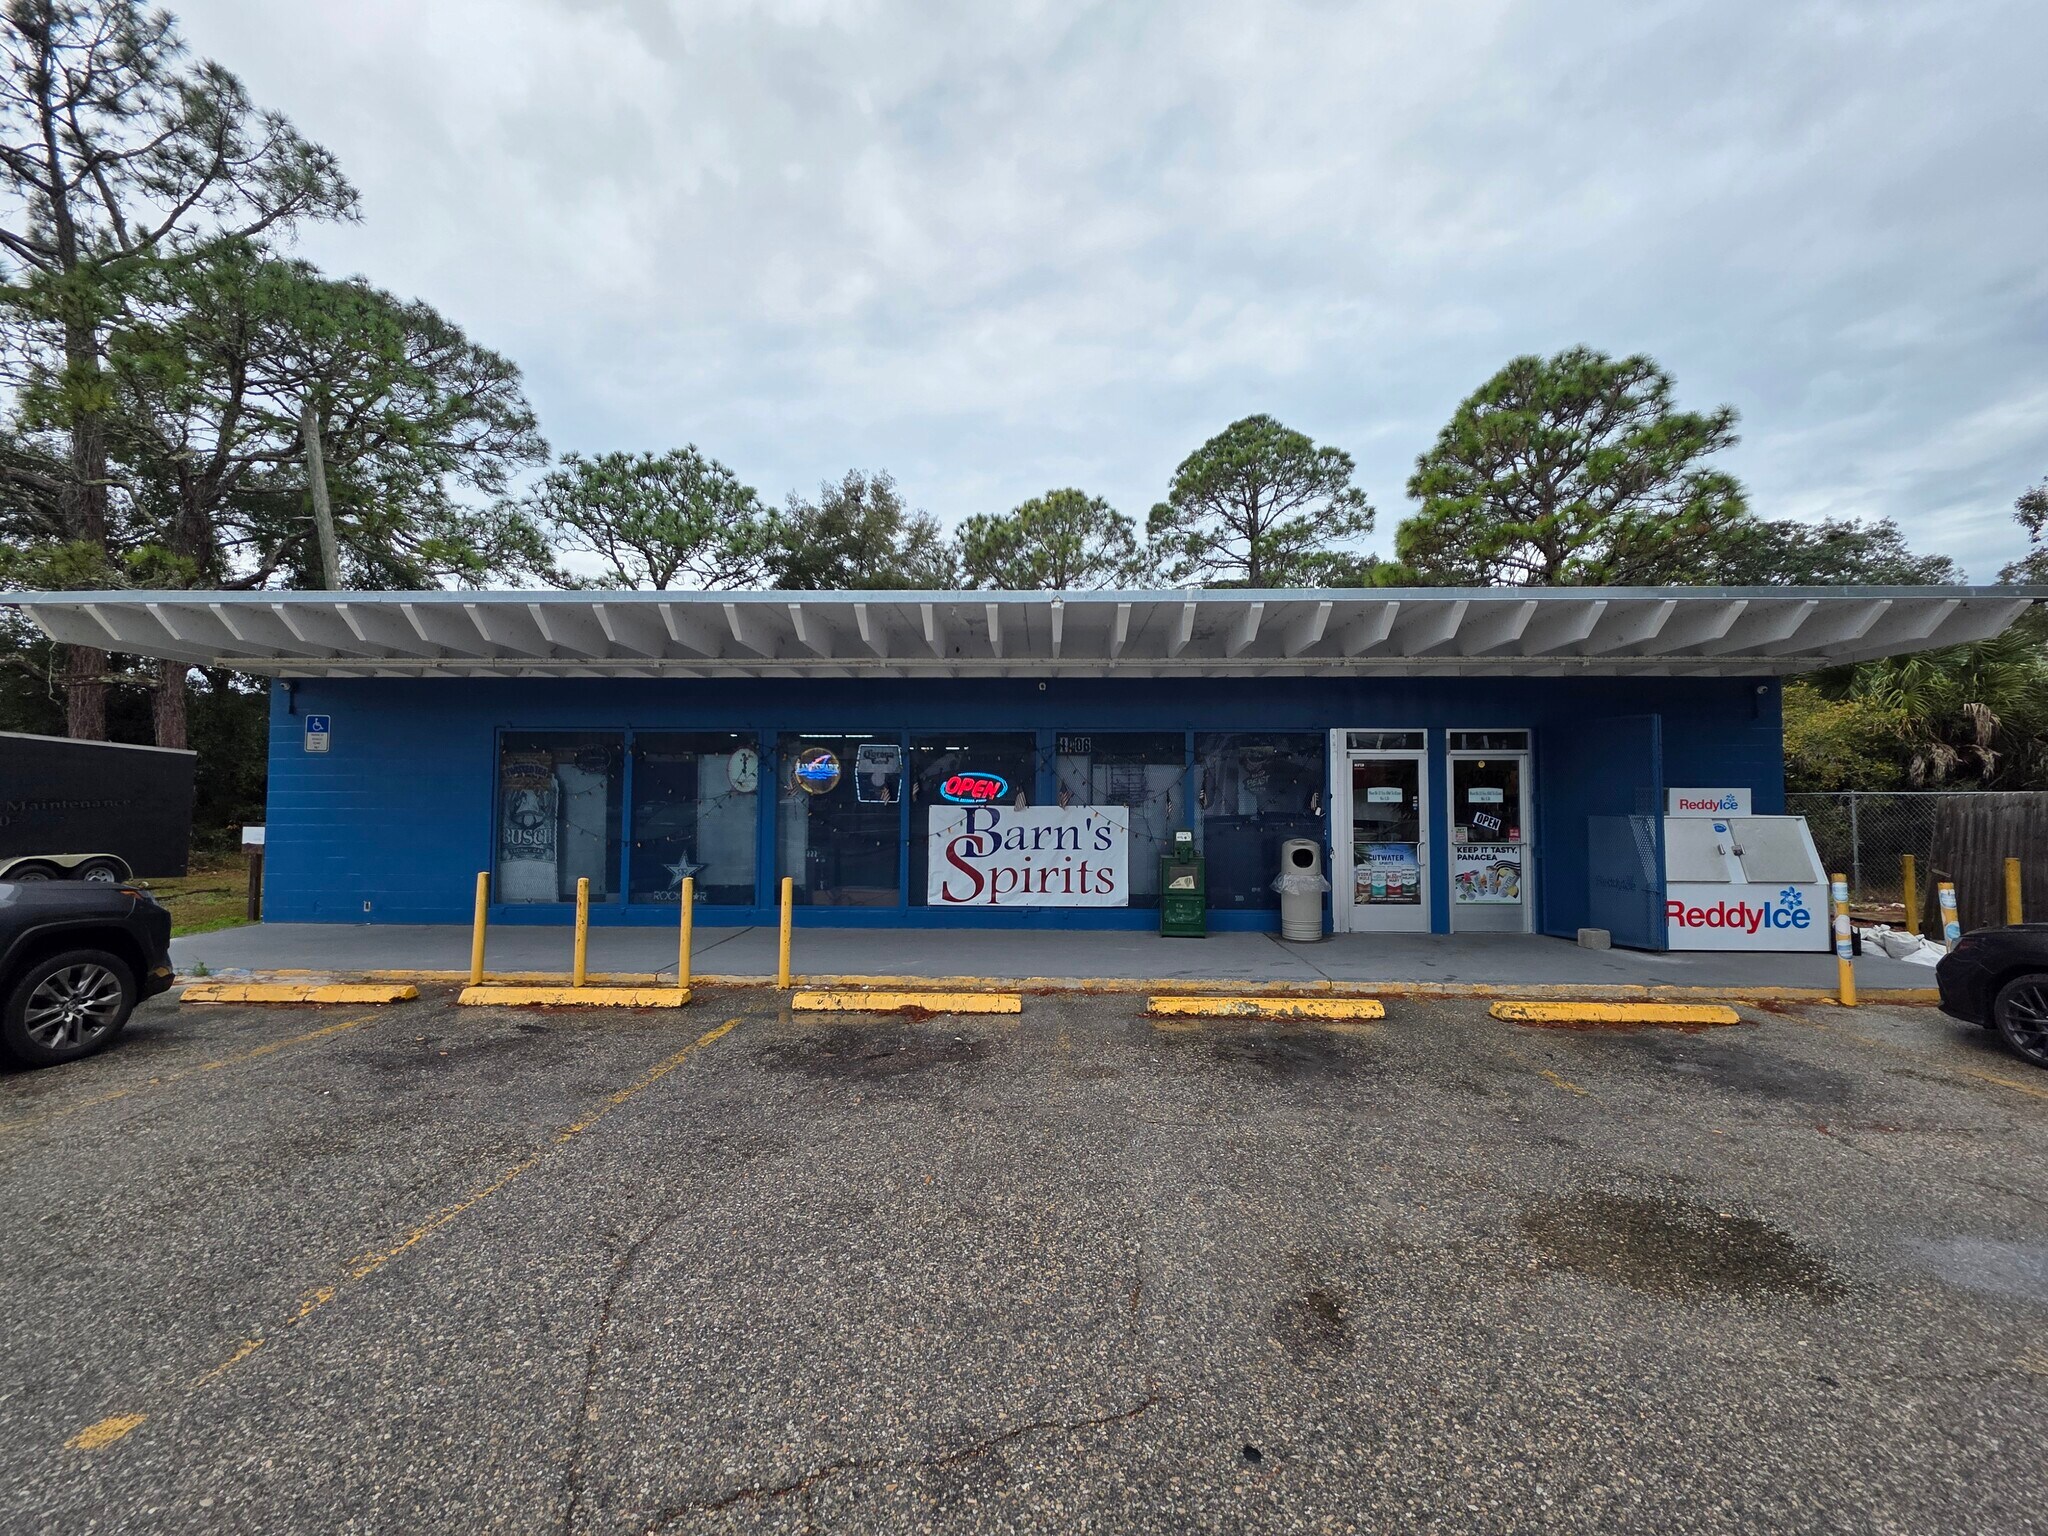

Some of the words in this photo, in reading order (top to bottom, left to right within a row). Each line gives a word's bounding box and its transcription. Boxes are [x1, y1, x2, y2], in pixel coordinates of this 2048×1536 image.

[945, 776, 1001, 800] OPEN
[7, 799, 132, 811] Maintenance
[1679, 799, 1739, 812] ReddyIce
[1476, 813, 1500, 830] OPEN
[503, 828, 552, 845] BUSCH
[961, 806, 1113, 859] Barn's
[1368, 854, 1405, 862] CUTWATER
[1457, 846, 1478, 854] KEEP
[1481, 846, 1489, 854] IT
[1490, 846, 1518, 854] TASTY,
[942, 835, 1115, 904] Spirits
[1666, 901, 1810, 934] ReddyIce
